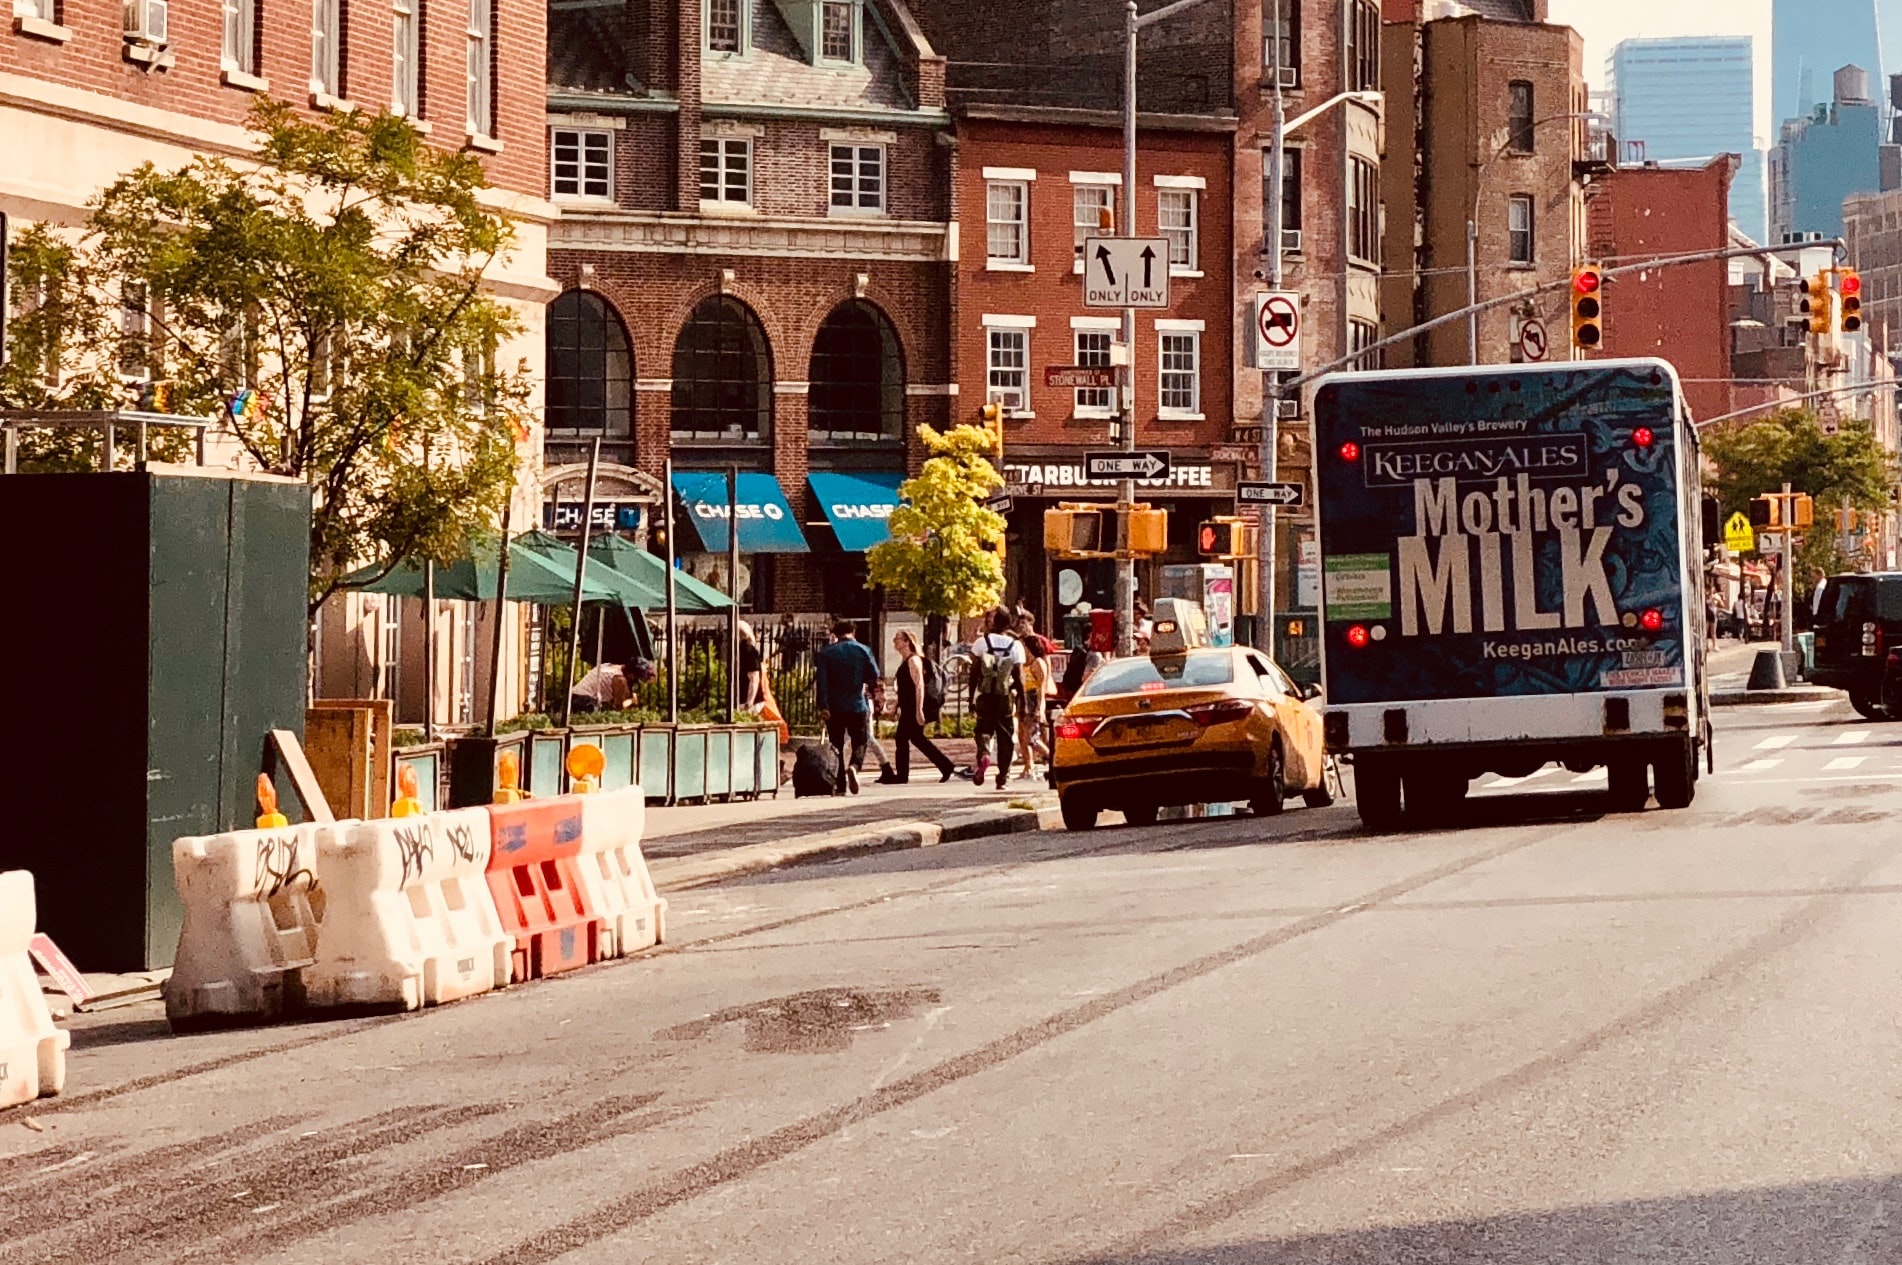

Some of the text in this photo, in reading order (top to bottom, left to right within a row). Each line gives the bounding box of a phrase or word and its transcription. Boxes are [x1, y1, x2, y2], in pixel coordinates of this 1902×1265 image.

[1089, 290, 1121, 302] ONLY
[1130, 290, 1164, 302] ONLY
[1048, 375, 1112, 386] STONEWALL PL
[1360, 419, 1528, 437] The Hudson Valley's Brewery
[1097, 460, 1157, 472] ONE WAY
[1374, 445, 1579, 480] KEEGAN ALES
[1003, 464, 1118, 486] TARBU
[1137, 465, 1212, 486] FFEE
[1246, 488, 1293, 499] ONE WAY
[1413, 467, 1645, 538] Mother's
[1397, 525, 1620, 637] MILK
